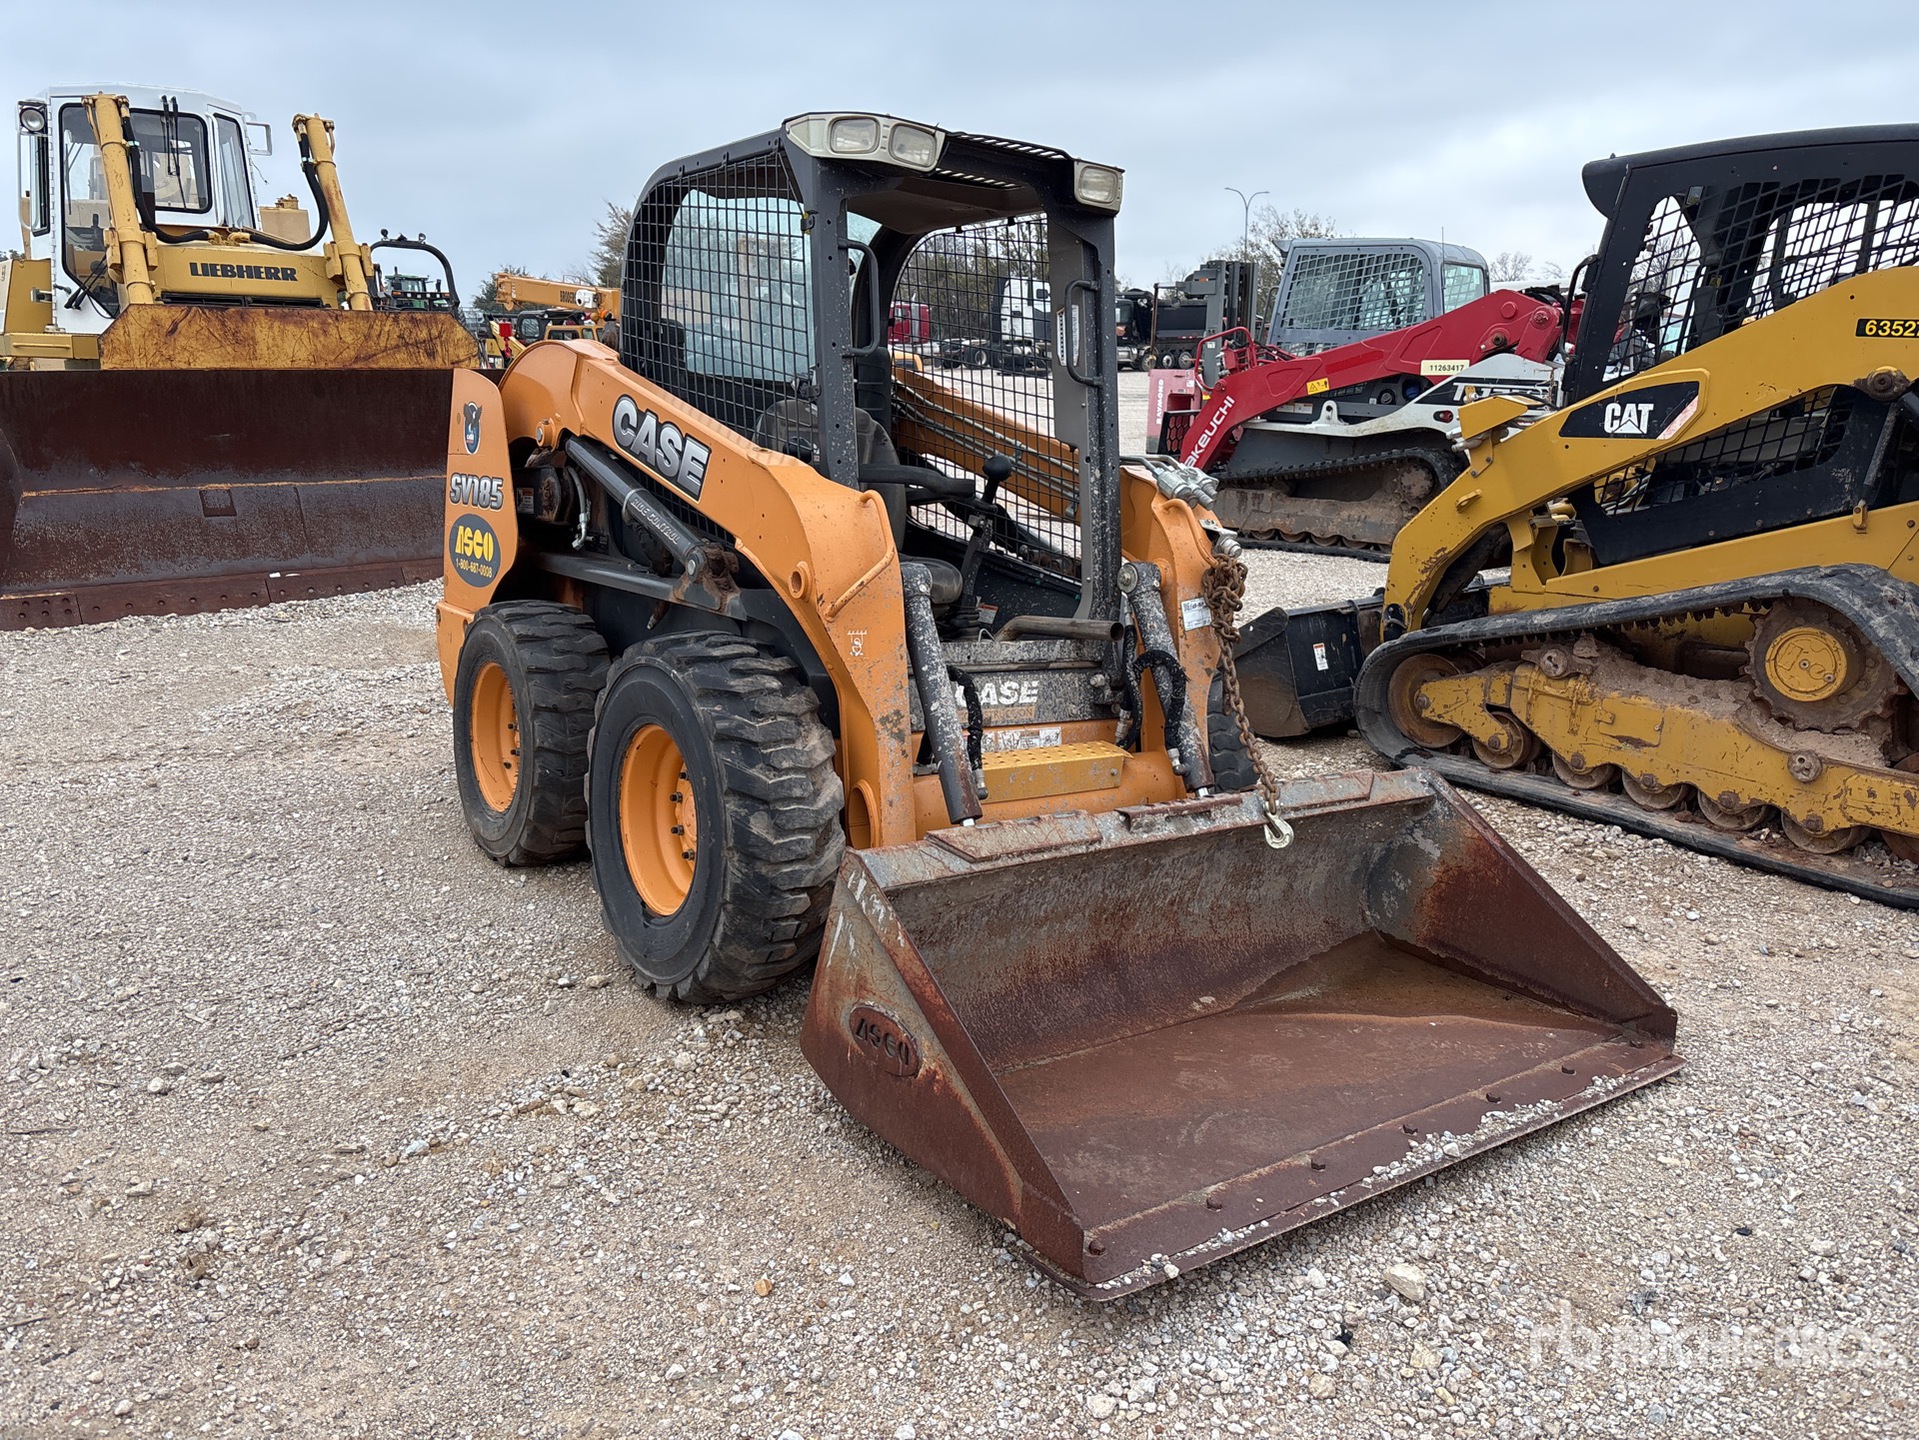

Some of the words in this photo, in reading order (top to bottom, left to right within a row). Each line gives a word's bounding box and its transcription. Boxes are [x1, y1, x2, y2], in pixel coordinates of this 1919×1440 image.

[189, 262, 298, 281] LIEBHERR
[1865, 320, 1919, 337] 6352
[1429, 364, 1465, 372] 11263417
[1156, 379, 1164, 425] RAYMOND
[1604, 403, 1654, 434] CAT
[612, 393, 712, 499] CASE
[1183, 395, 1235, 467] AKEUCHI
[450, 474, 503, 511] SV185
[630, 498, 650, 517] RIDE
[648, 512, 681, 545] CONTROL
[455, 525, 494, 562] ASCO
[855, 1017, 910, 1066] ASCO
